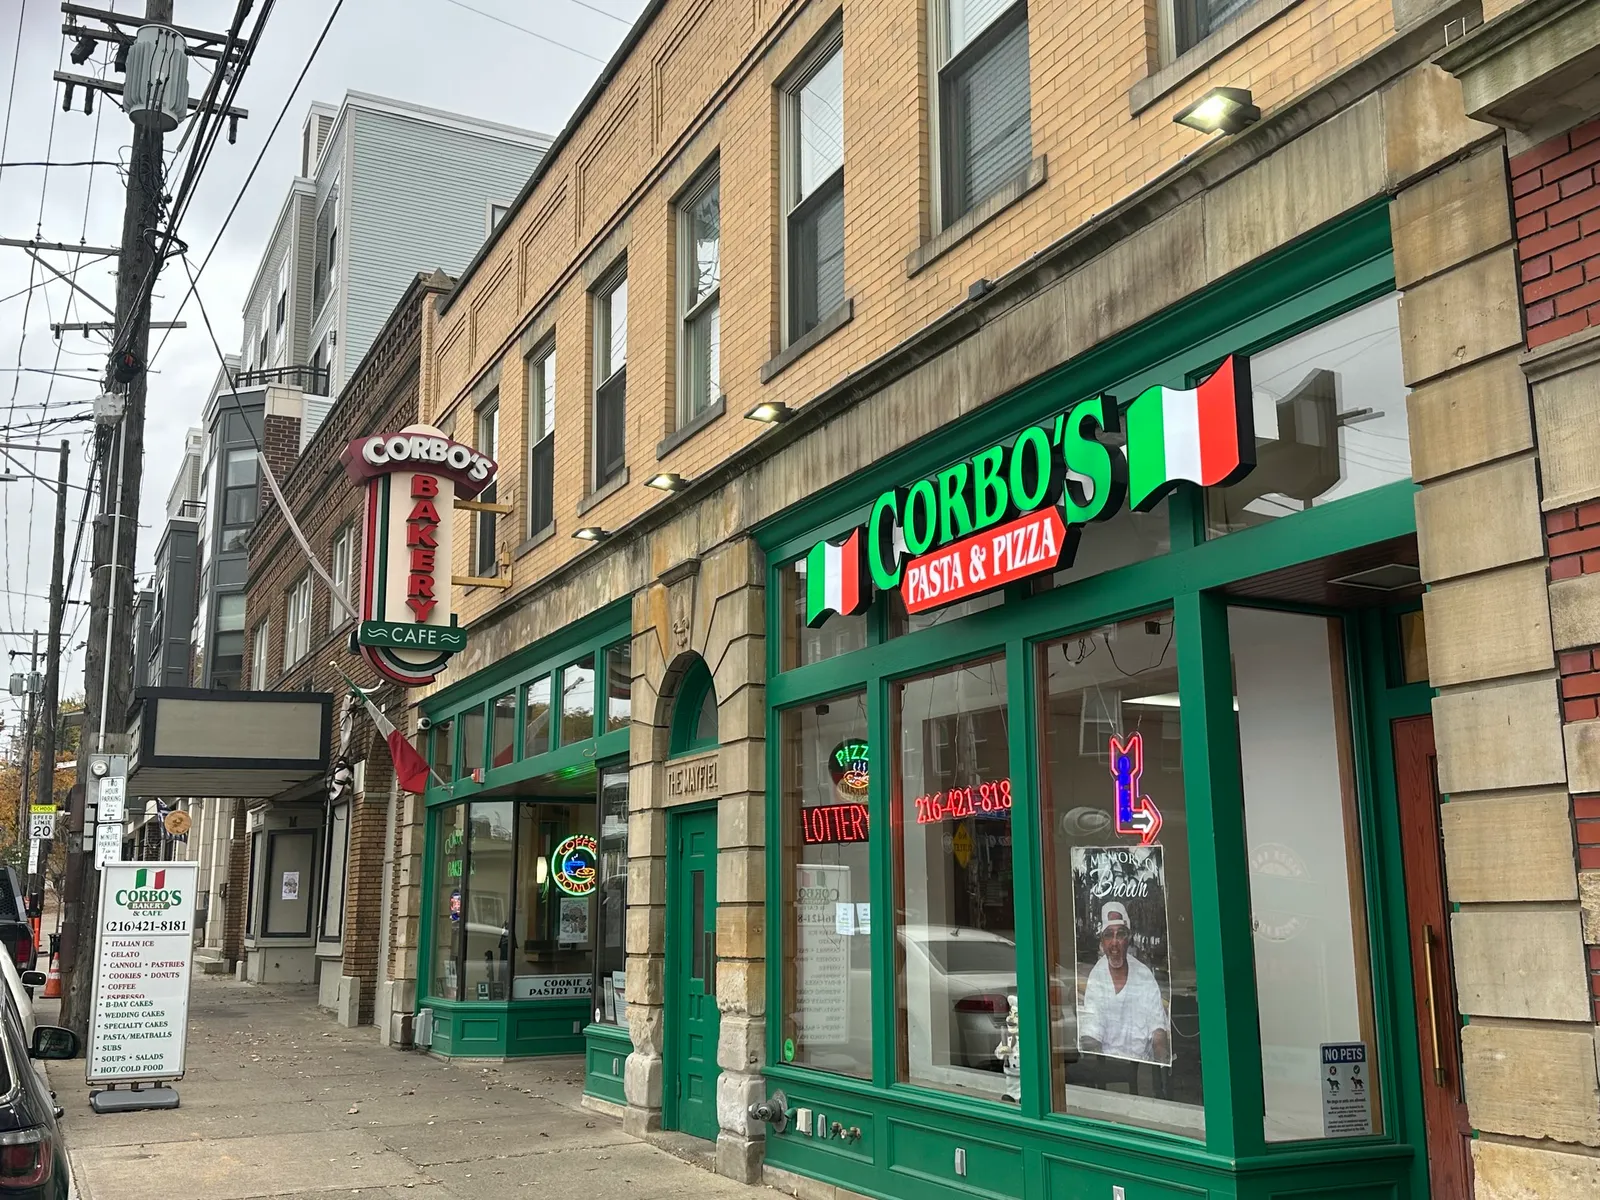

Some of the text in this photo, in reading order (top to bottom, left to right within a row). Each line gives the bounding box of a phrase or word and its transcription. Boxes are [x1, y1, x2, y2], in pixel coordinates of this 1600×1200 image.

[362, 436, 493, 482] CORBO'S
[868, 393, 1112, 590] CORBO'S
[406, 474, 440, 623] BAKERY
[907, 517, 1057, 604] PASTA & PIZZA
[391, 627, 437, 645] CAFE
[835, 744, 869, 767] PIZZ
[667, 762, 719, 797] THE MAYFIEL
[915, 780, 1012, 824] 216-421-818
[33, 825, 51, 837] 20
[802, 804, 870, 842] LOTTERY
[558, 837, 597, 856] COFFE
[115, 889, 182, 906] CORBO'S
[106, 920, 186, 932] (216)421-8181
[528, 986, 592, 996] PASTRY TRA
[543, 978, 582, 988] COOKIE
[104, 1010, 165, 1019] WEDDING CAKES
[103, 1022, 144, 1030] SPECIALTY
[103, 1031, 172, 1040] PASTA/MEATBALLS
[135, 1053, 164, 1061] SALADS
[1325, 1048, 1363, 1061] NO PETS
[100, 1065, 141, 1073] HOT/COLD
